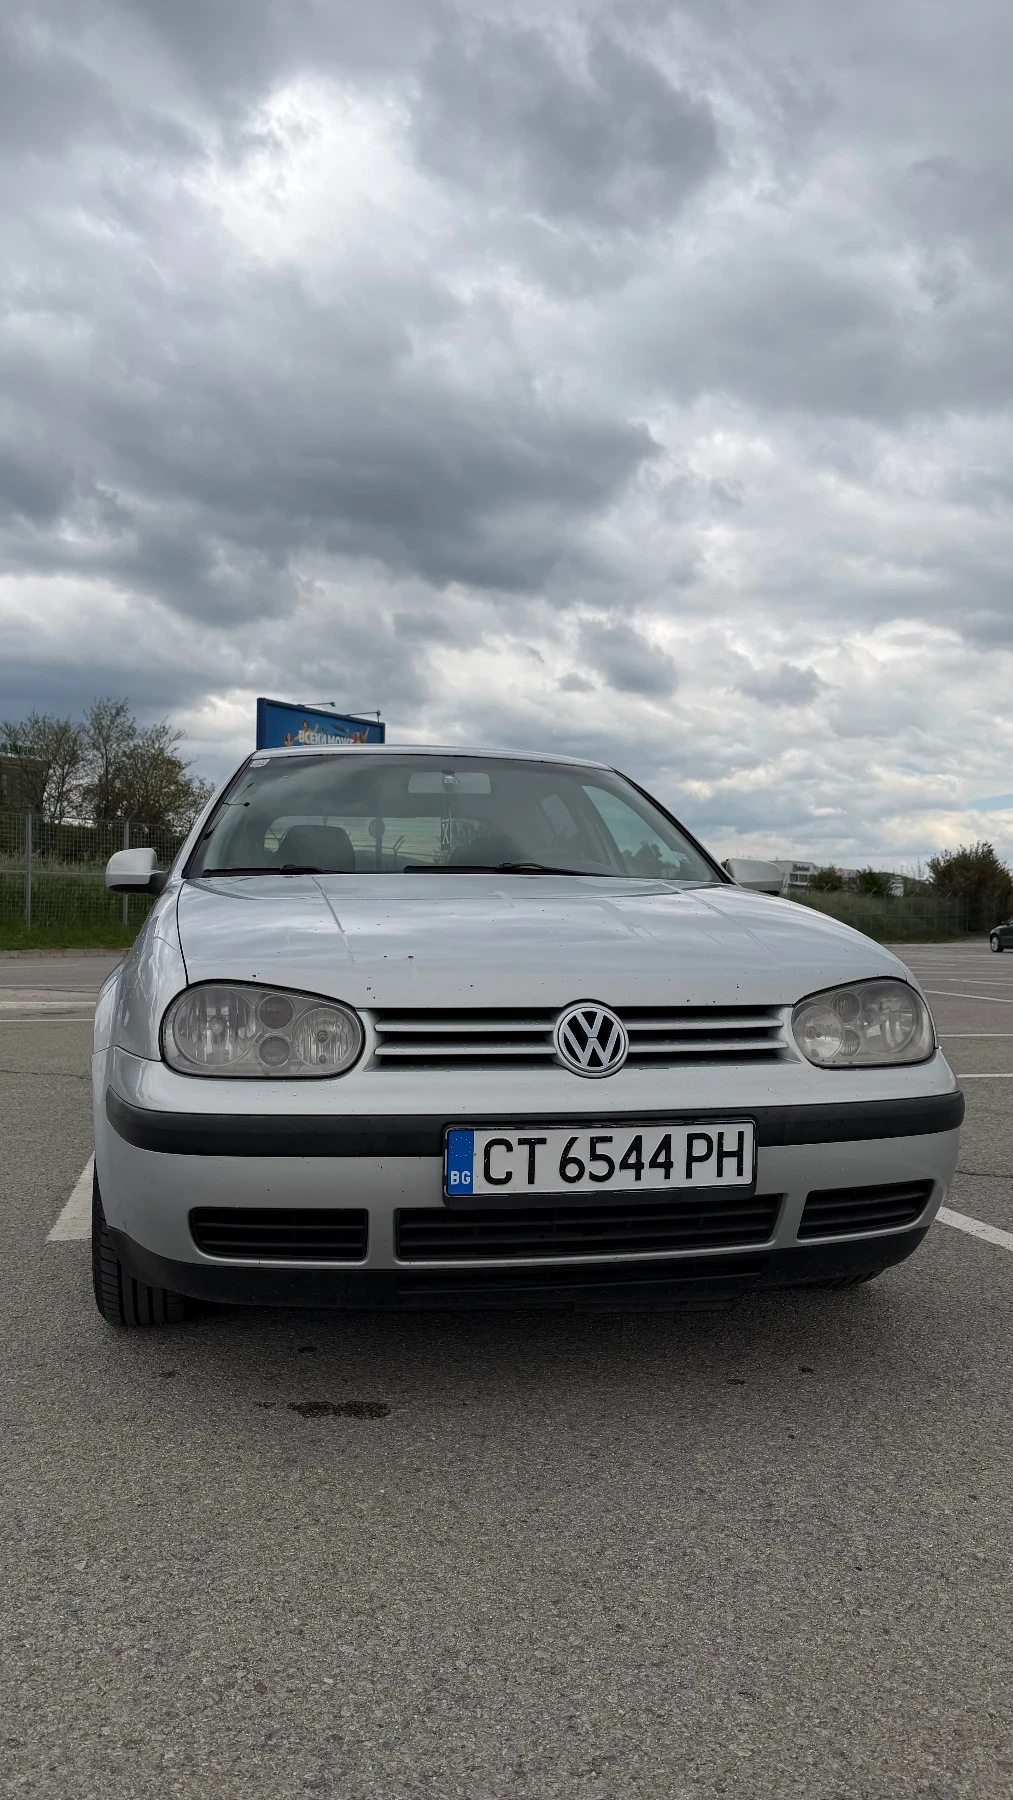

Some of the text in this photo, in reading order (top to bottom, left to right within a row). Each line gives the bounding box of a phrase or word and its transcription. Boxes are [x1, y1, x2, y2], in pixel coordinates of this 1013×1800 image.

[558, 1007, 625, 1071] VW
[450, 1171, 471, 1185] BG
[483, 1131, 745, 1185] CT 6544 PH
